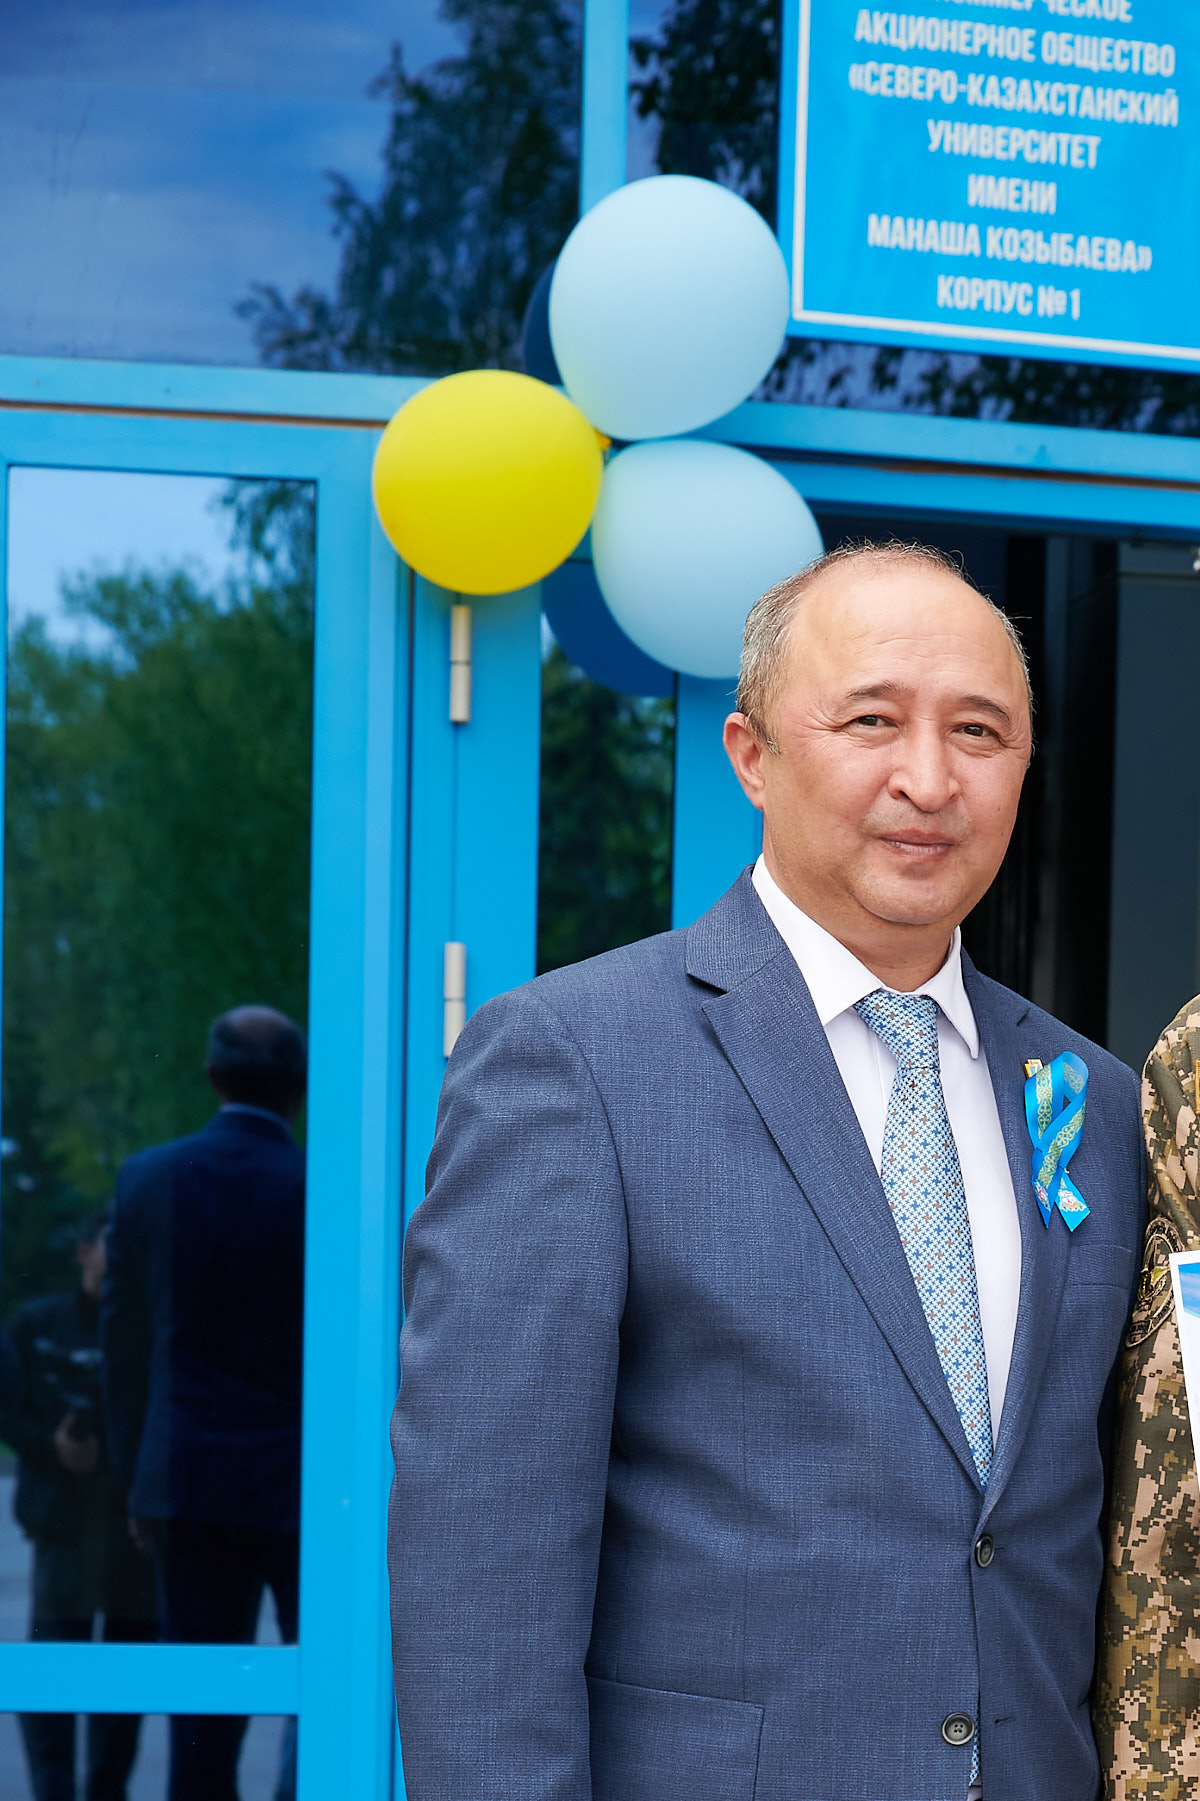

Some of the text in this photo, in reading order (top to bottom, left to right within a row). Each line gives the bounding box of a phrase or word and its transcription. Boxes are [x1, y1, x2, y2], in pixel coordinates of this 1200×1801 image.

[855, 10, 1037, 63] АКЦИОНЕРНОЕ
[1041, 32, 1176, 77] ОБЩЕСТВО
[849, 61, 1179, 128] «СЕВЕРО-КАЗАХСТАНСКИЙ
[927, 119, 1101, 169] УНИВЕРСИТЕТ
[967, 174, 1057, 215] ИМЕНИ
[868, 214, 1152, 273] МАНАША КОЗЫБАЕВА»
[937, 275, 1033, 315] КОРПУС
